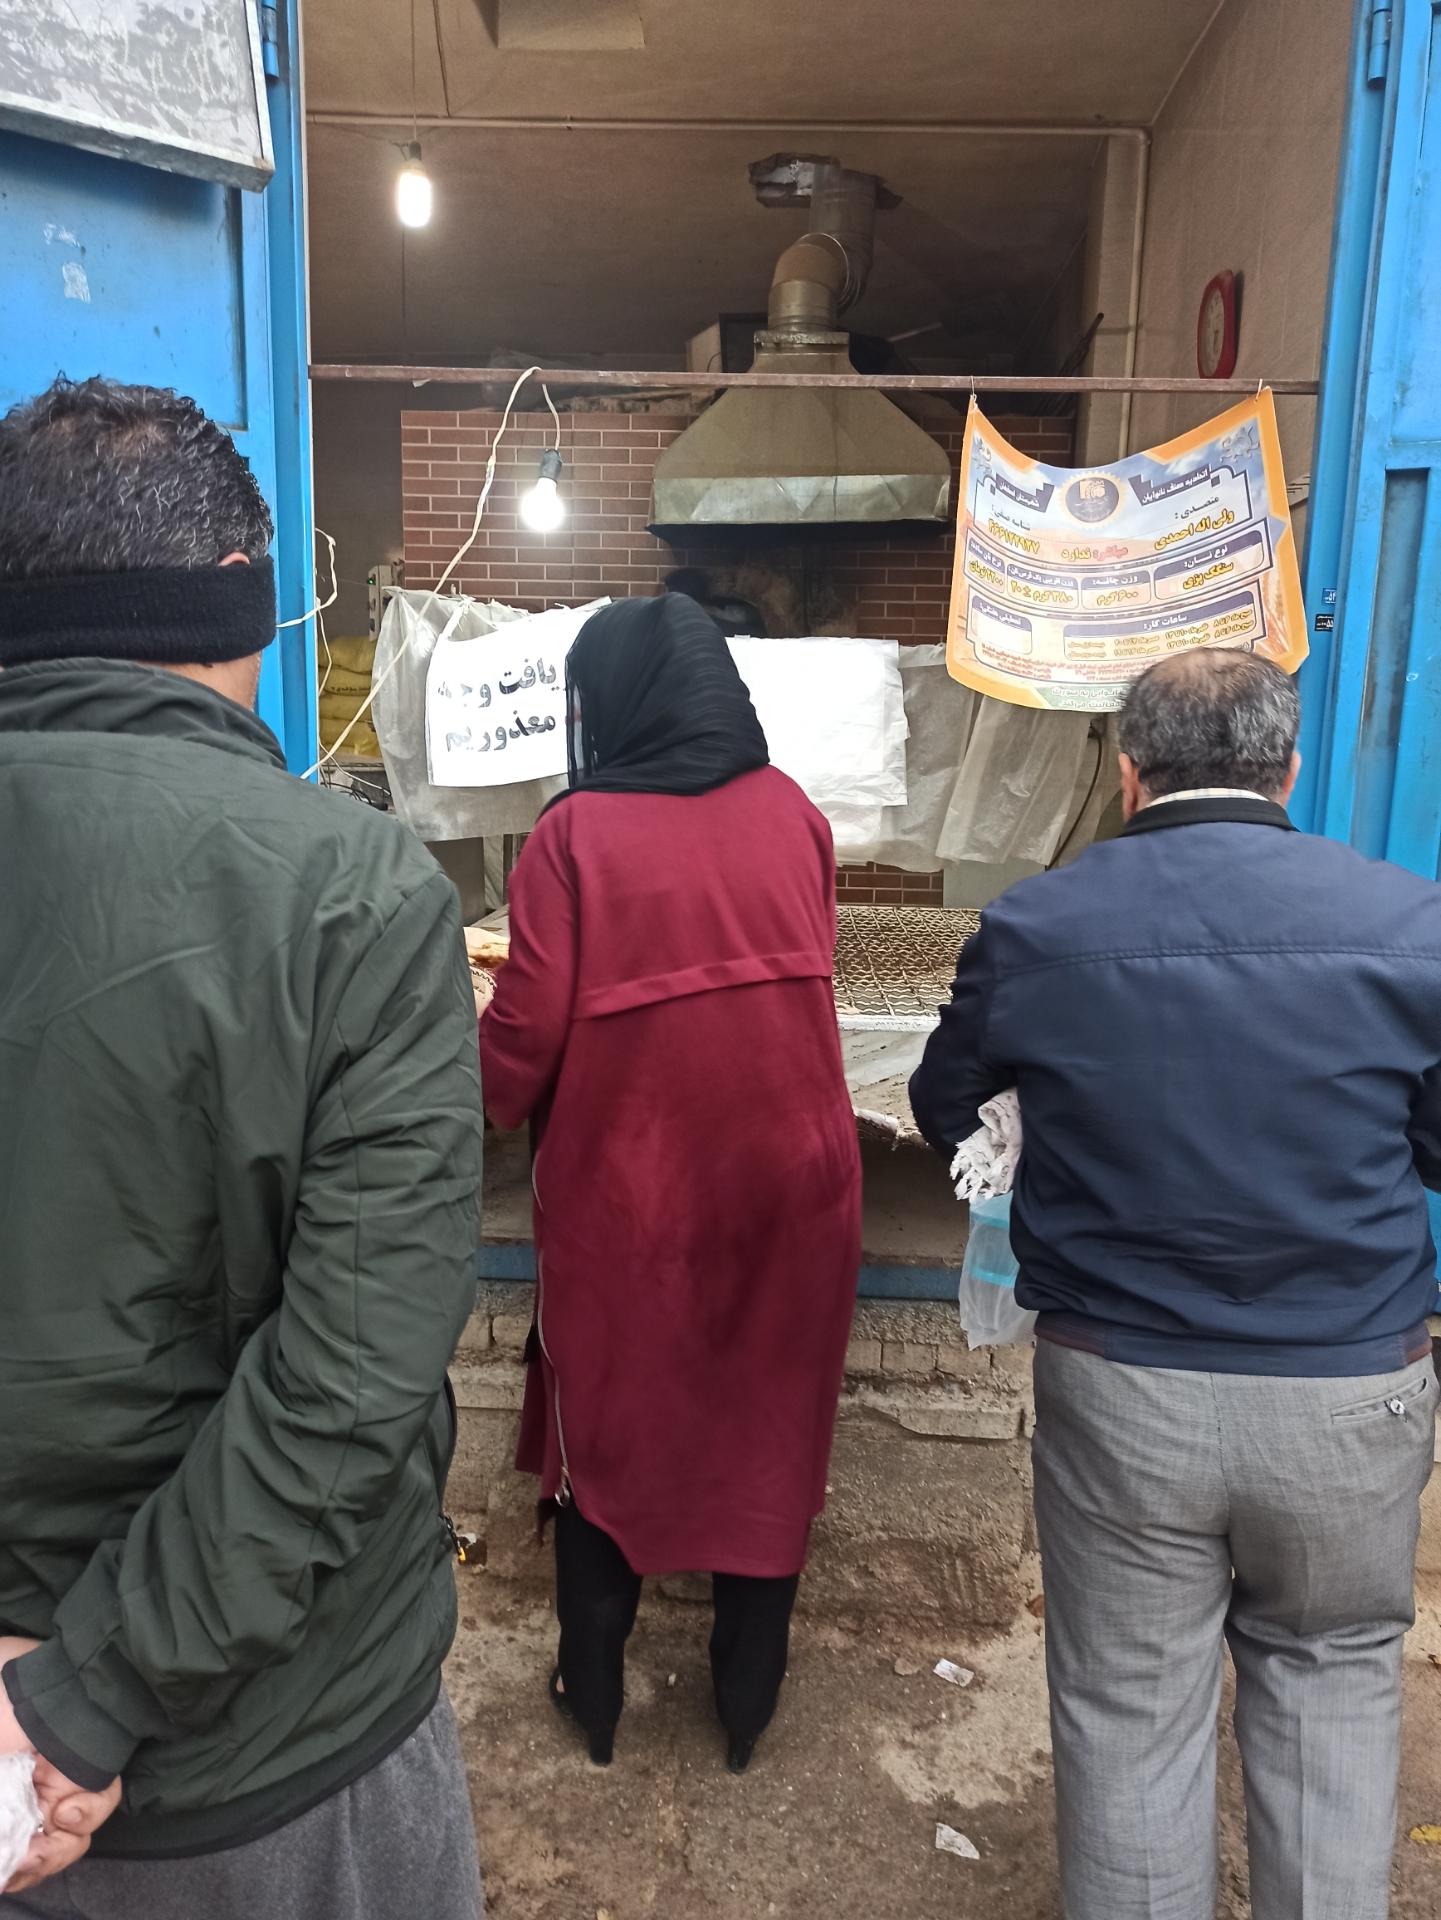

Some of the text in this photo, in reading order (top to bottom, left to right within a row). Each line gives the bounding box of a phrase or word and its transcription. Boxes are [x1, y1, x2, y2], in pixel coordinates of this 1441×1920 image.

[1142, 469, 1209, 504] اتحادیه صنف نانوایان
[1154, 507, 1235, 551] ولی اله احمدی
[1214, 545, 1229, 559] نوع
[1121, 575, 1138, 585] وزن
[1183, 562, 1234, 589] سنگک پزی
[1162, 614, 1188, 627] ساعات
[499, 657, 566, 695] یافت
[445, 710, 556, 752] معذوریم
